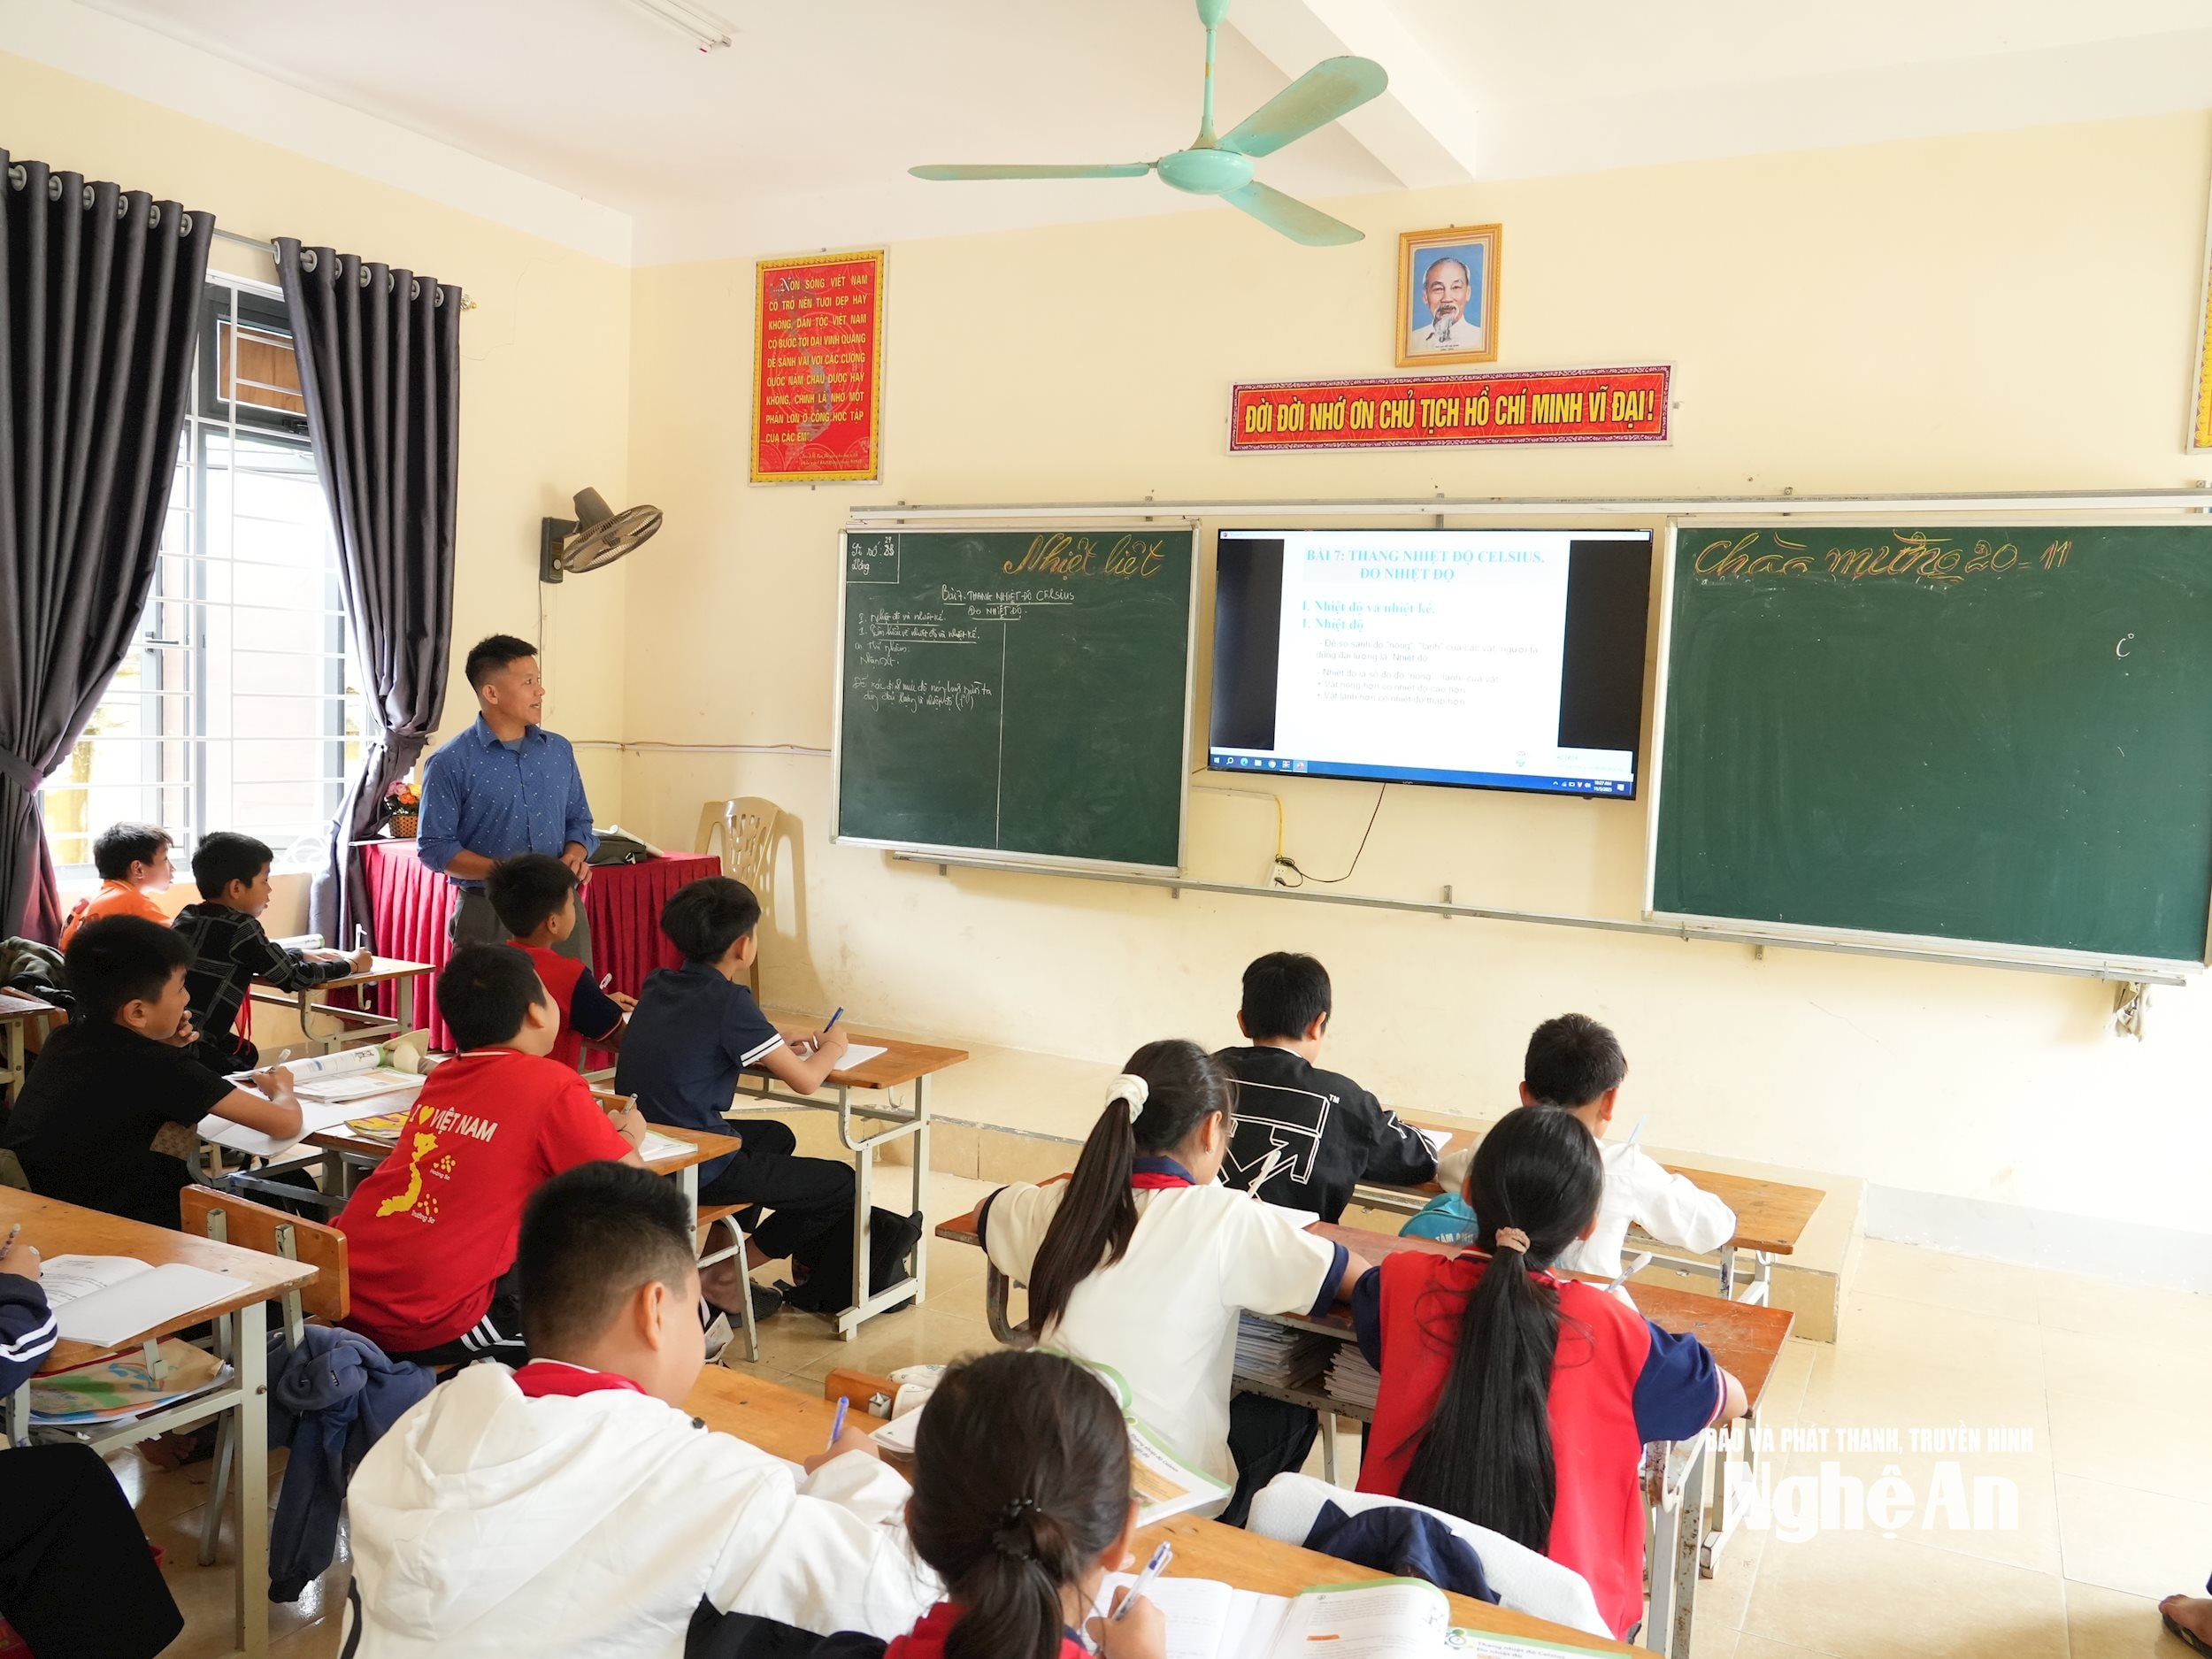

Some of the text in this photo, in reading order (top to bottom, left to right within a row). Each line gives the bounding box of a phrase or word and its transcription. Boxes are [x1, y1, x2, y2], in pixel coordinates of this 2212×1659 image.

[805, 276, 825, 288] SÔNG
[831, 274, 846, 289] VIỆT
[851, 275, 868, 285] NAM
[769, 299, 778, 311] CÓ
[799, 298, 811, 309] NÊN
[817, 296, 832, 307] TƯƠI
[835, 296, 849, 309] ĐẸP
[853, 294, 867, 304] HAY
[797, 316, 811, 327] DÂN
[815, 314, 828, 330] TỘC
[833, 313, 847, 326] VIỆT
[851, 314, 866, 324] NAM
[824, 335, 839, 345] VINH
[841, 334, 865, 343] QUANG
[779, 353, 795, 367] SÁNH
[798, 354, 810, 366] VAI
[811, 352, 823, 365] VỚI
[825, 351, 839, 365] CÁC
[807, 372, 825, 384] CHÂU
[850, 373, 864, 382] HAY
[795, 392, 814, 403] CHÍNH
[818, 390, 826, 403] LÀ
[849, 390, 864, 404] MỘT
[811, 411, 829, 422] CÔNG
[833, 411, 847, 425] HỌC
[850, 409, 864, 424] TẬP
[1245, 396, 1272, 433] ĐỜI
[1277, 396, 1305, 432] ĐỜI
[1310, 396, 1347, 431] NHỚ
[1349, 398, 1375, 430] ƠN
[1379, 388, 1415, 429] CHỦ
[1420, 396, 1460, 434] TỊCH
[1464, 386, 1490, 426] HỒ
[1494, 387, 1528, 426] CHÍ
[1531, 392, 1583, 425] MINH
[1588, 385, 1609, 423] VĨ
[766, 429, 779, 442] CỦA
[782, 430, 795, 442] CÁC
[1002, 533, 1165, 580] Nhiệt liệt
[1306, 548, 1545, 565] BÀI 7: THANG NHIỆT ĐỘ CELSIUS.
[1360, 566, 1455, 583] ĐO NHIỆT ĐỘ
[1315, 599, 1345, 614] Nhiệt
[1348, 599, 1364, 614] độ
[1384, 600, 1415, 616] nhiệt
[1315, 617, 1346, 632] Nhiệt
[1348, 617, 1364, 632] độ
[1329, 1094, 1340, 1104] TM
[410, 1104, 498, 1142] I VIỆT NAM
